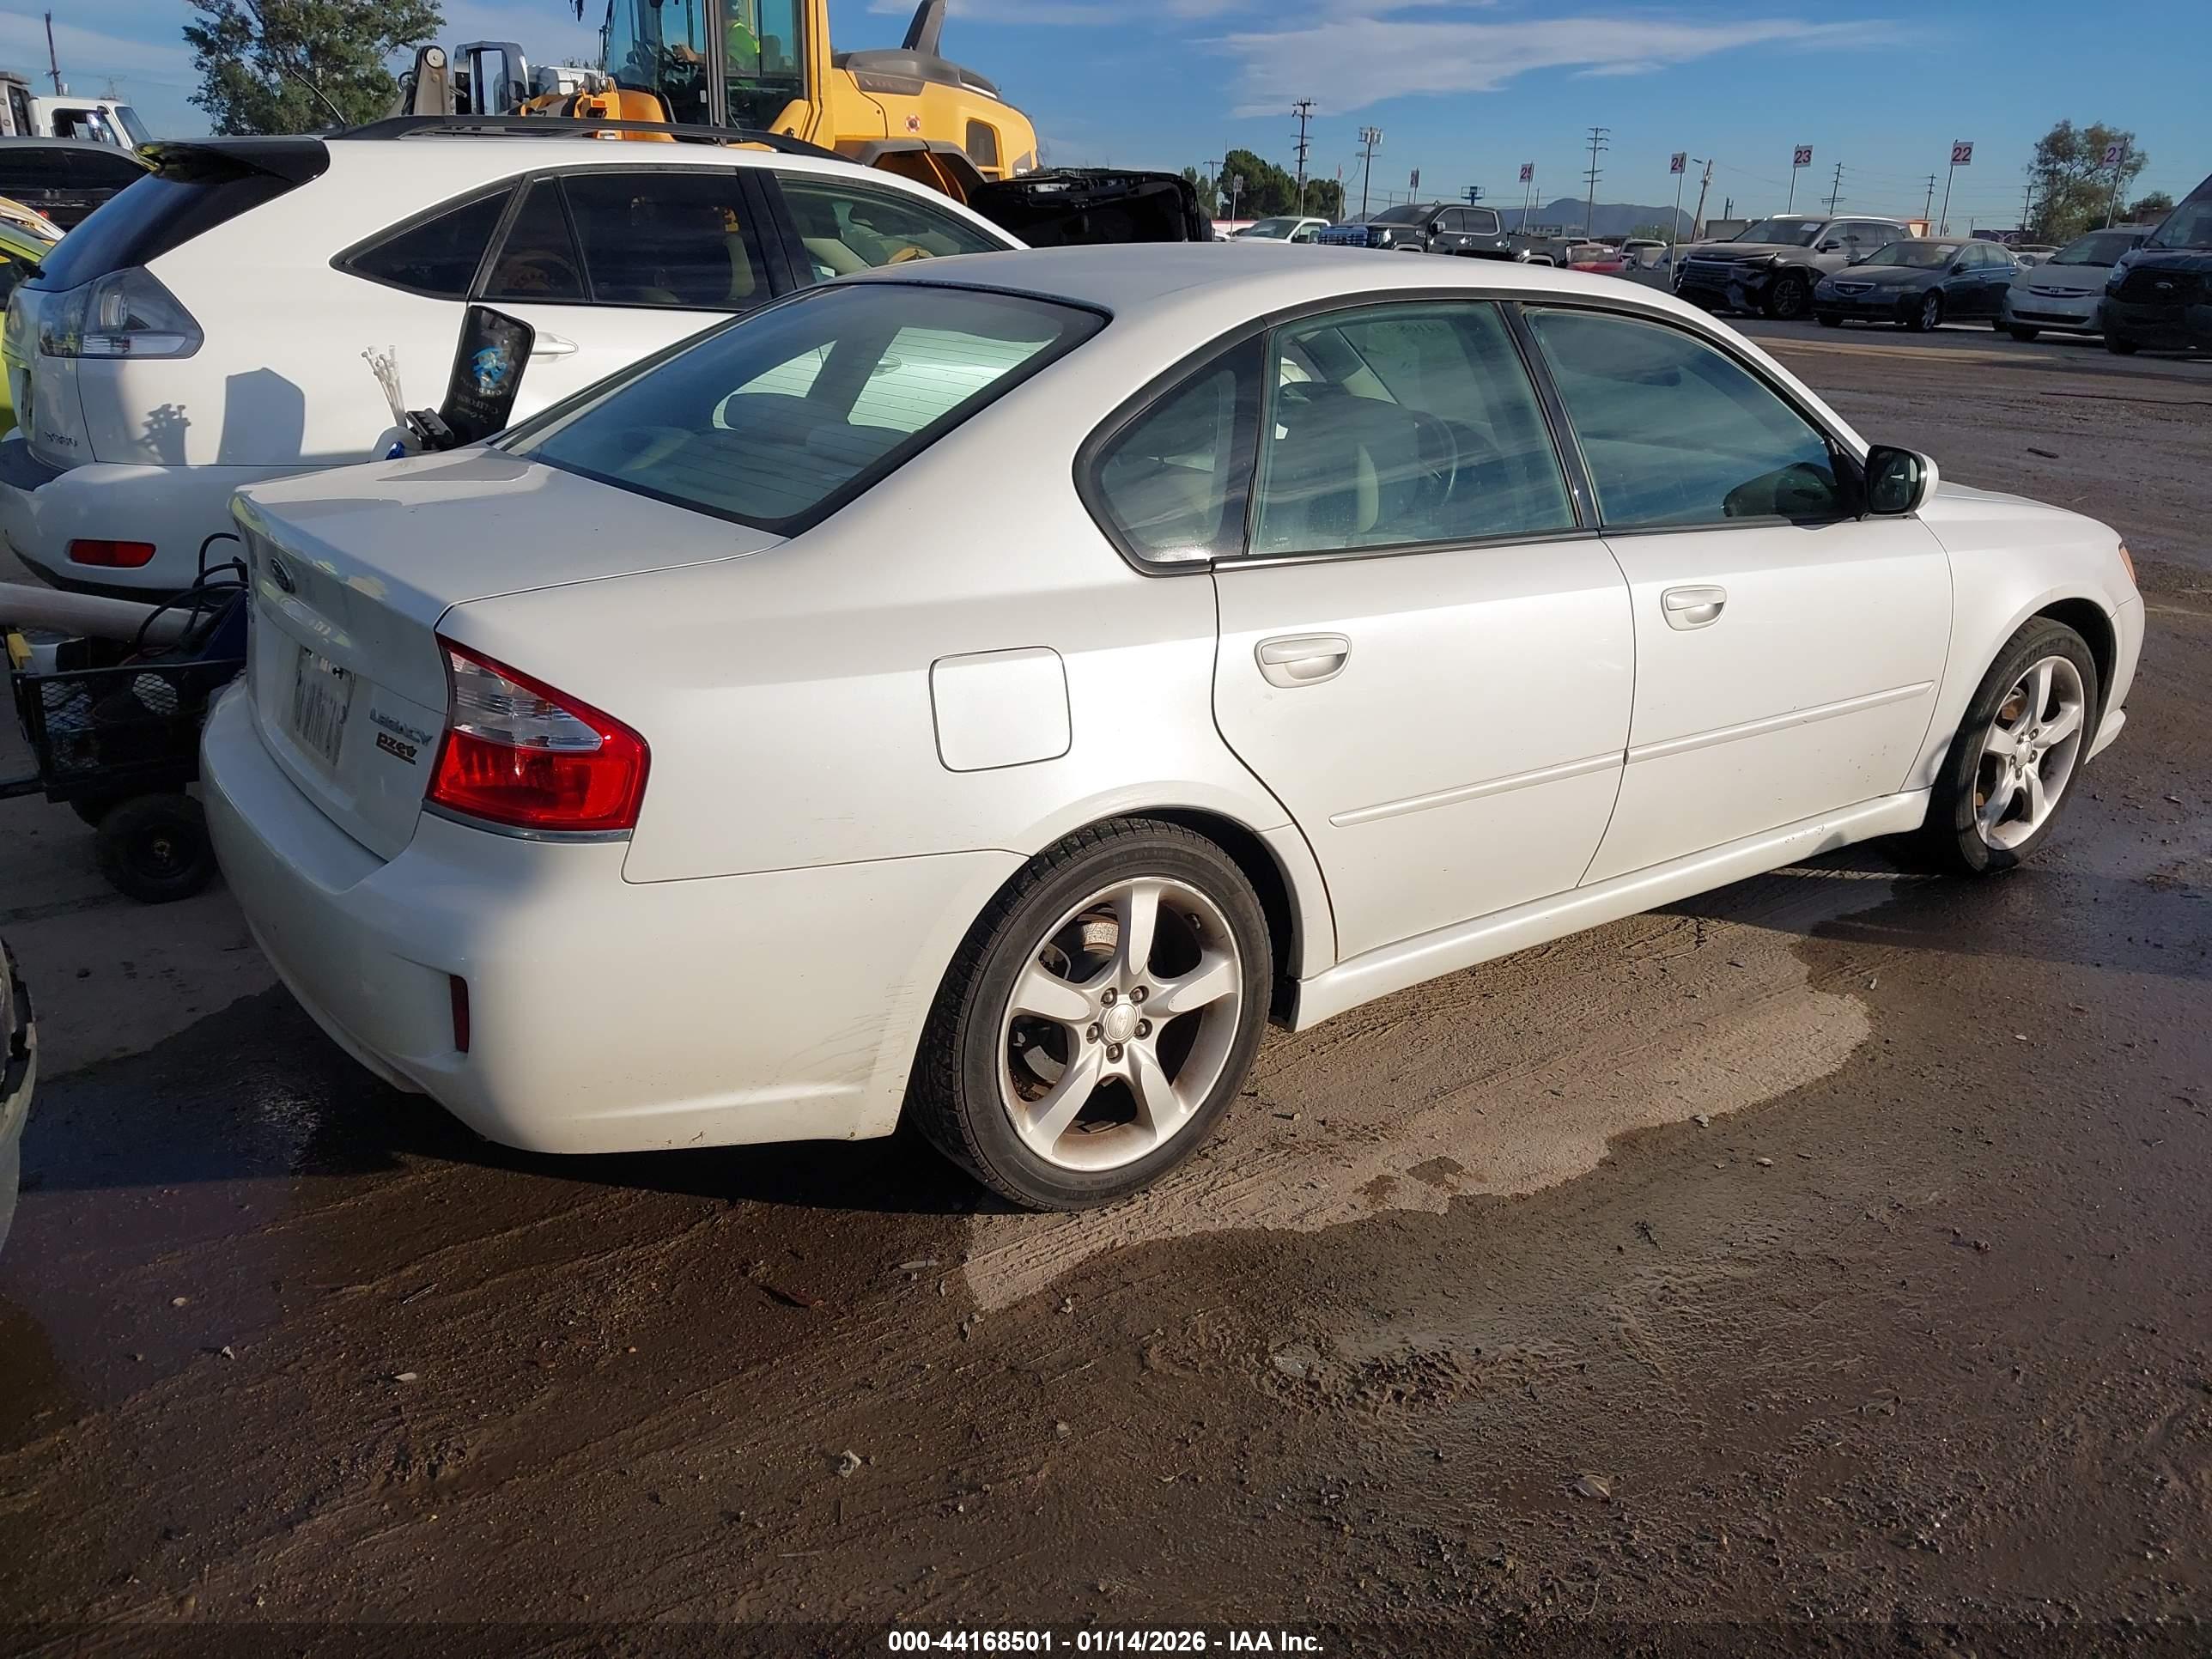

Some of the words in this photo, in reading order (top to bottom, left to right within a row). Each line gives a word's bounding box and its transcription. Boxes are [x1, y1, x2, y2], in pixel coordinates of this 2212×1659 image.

[1795, 149, 1811, 163] 23
[1952, 147, 1972, 161] 22
[1671, 157, 1684, 170] 24
[369, 708, 433, 746] LEGACY
